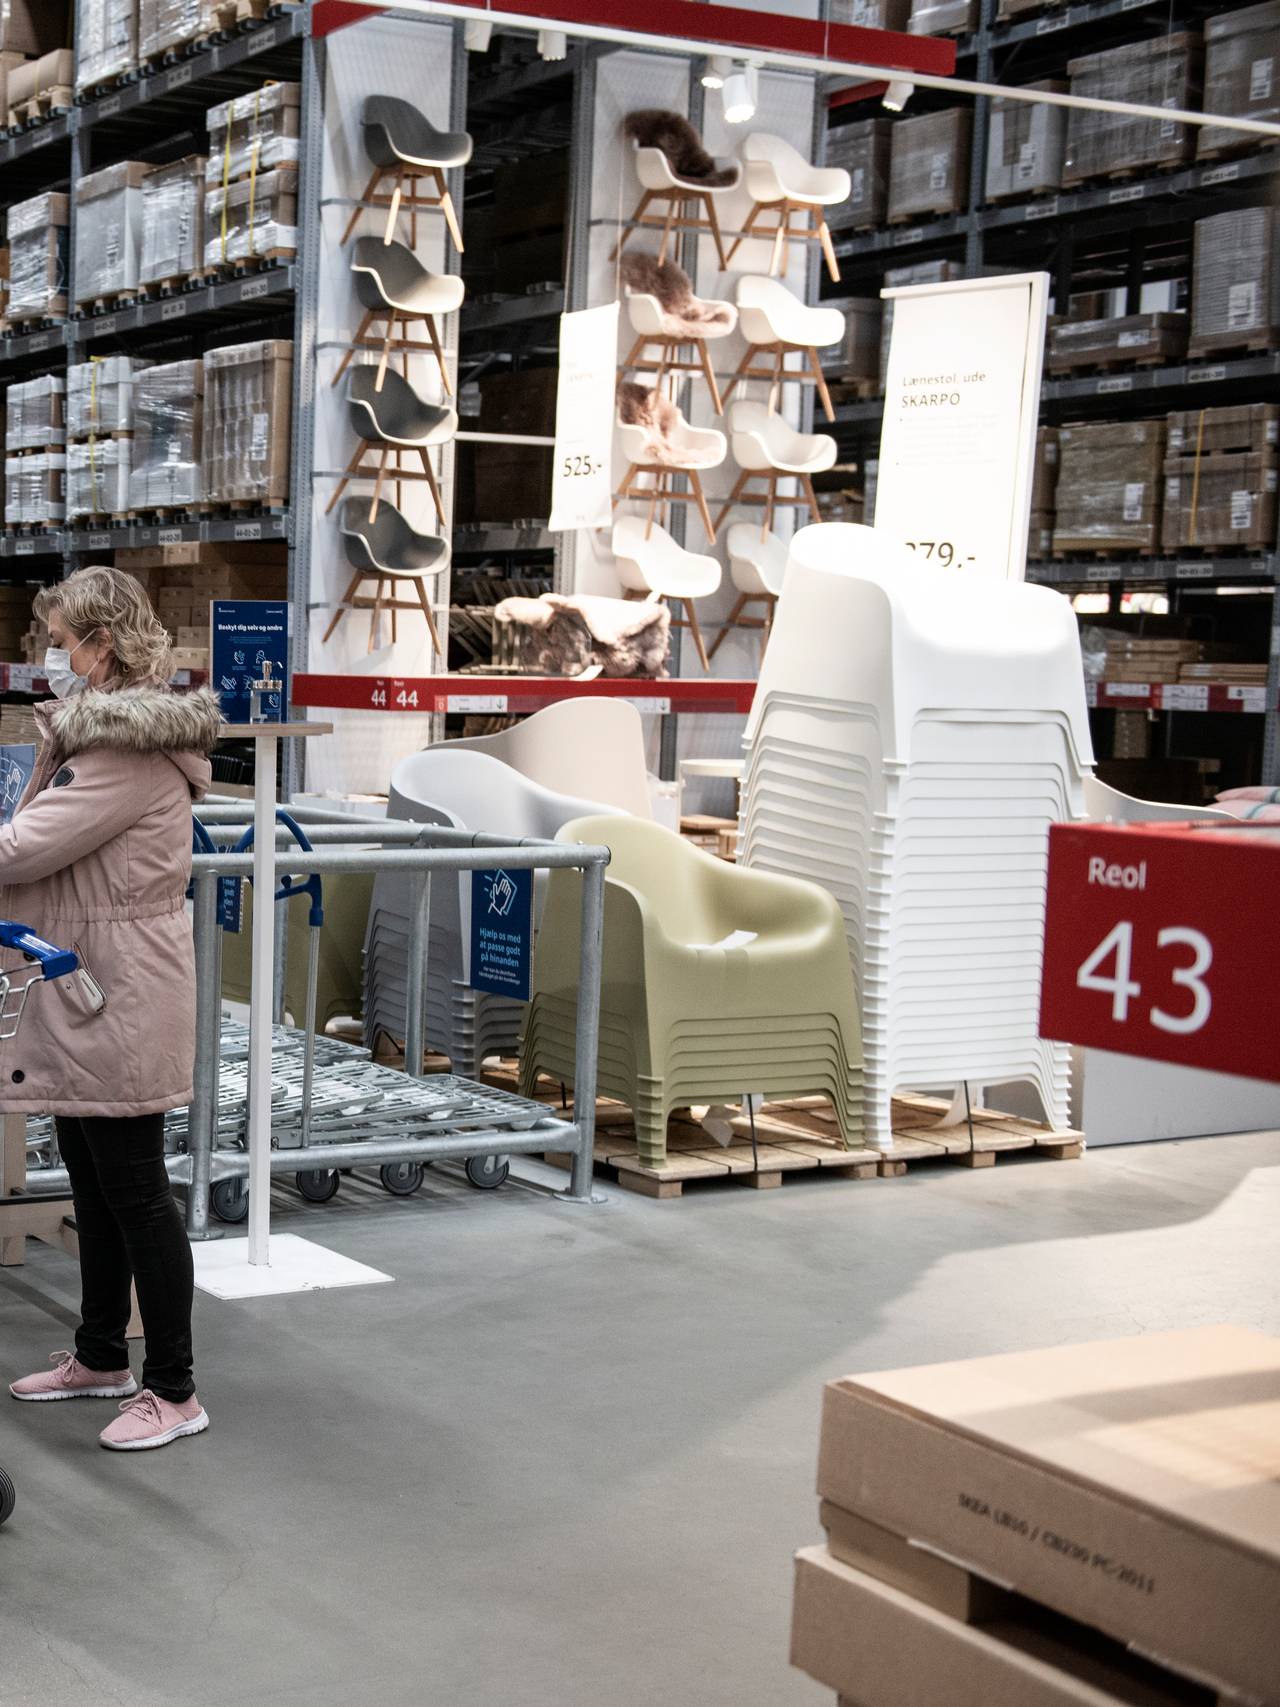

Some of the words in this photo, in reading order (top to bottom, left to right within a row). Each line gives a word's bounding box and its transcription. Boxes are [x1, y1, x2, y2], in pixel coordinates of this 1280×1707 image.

[963, 371, 986, 384] ude
[563, 456, 602, 477] 525.-
[371, 689, 386, 707] 44
[396, 690, 419, 707] 44
[1088, 856, 1147, 891] Reol
[480, 928, 498, 941] Hjælp
[498, 932, 506, 941] os
[506, 934, 521, 943] med
[479, 941, 486, 949] at
[487, 943, 505, 952] passe
[506, 946, 521, 956] godt
[480, 952, 489, 962] på
[490, 953, 519, 967] hinanden
[1076, 920, 1213, 1035] 43
